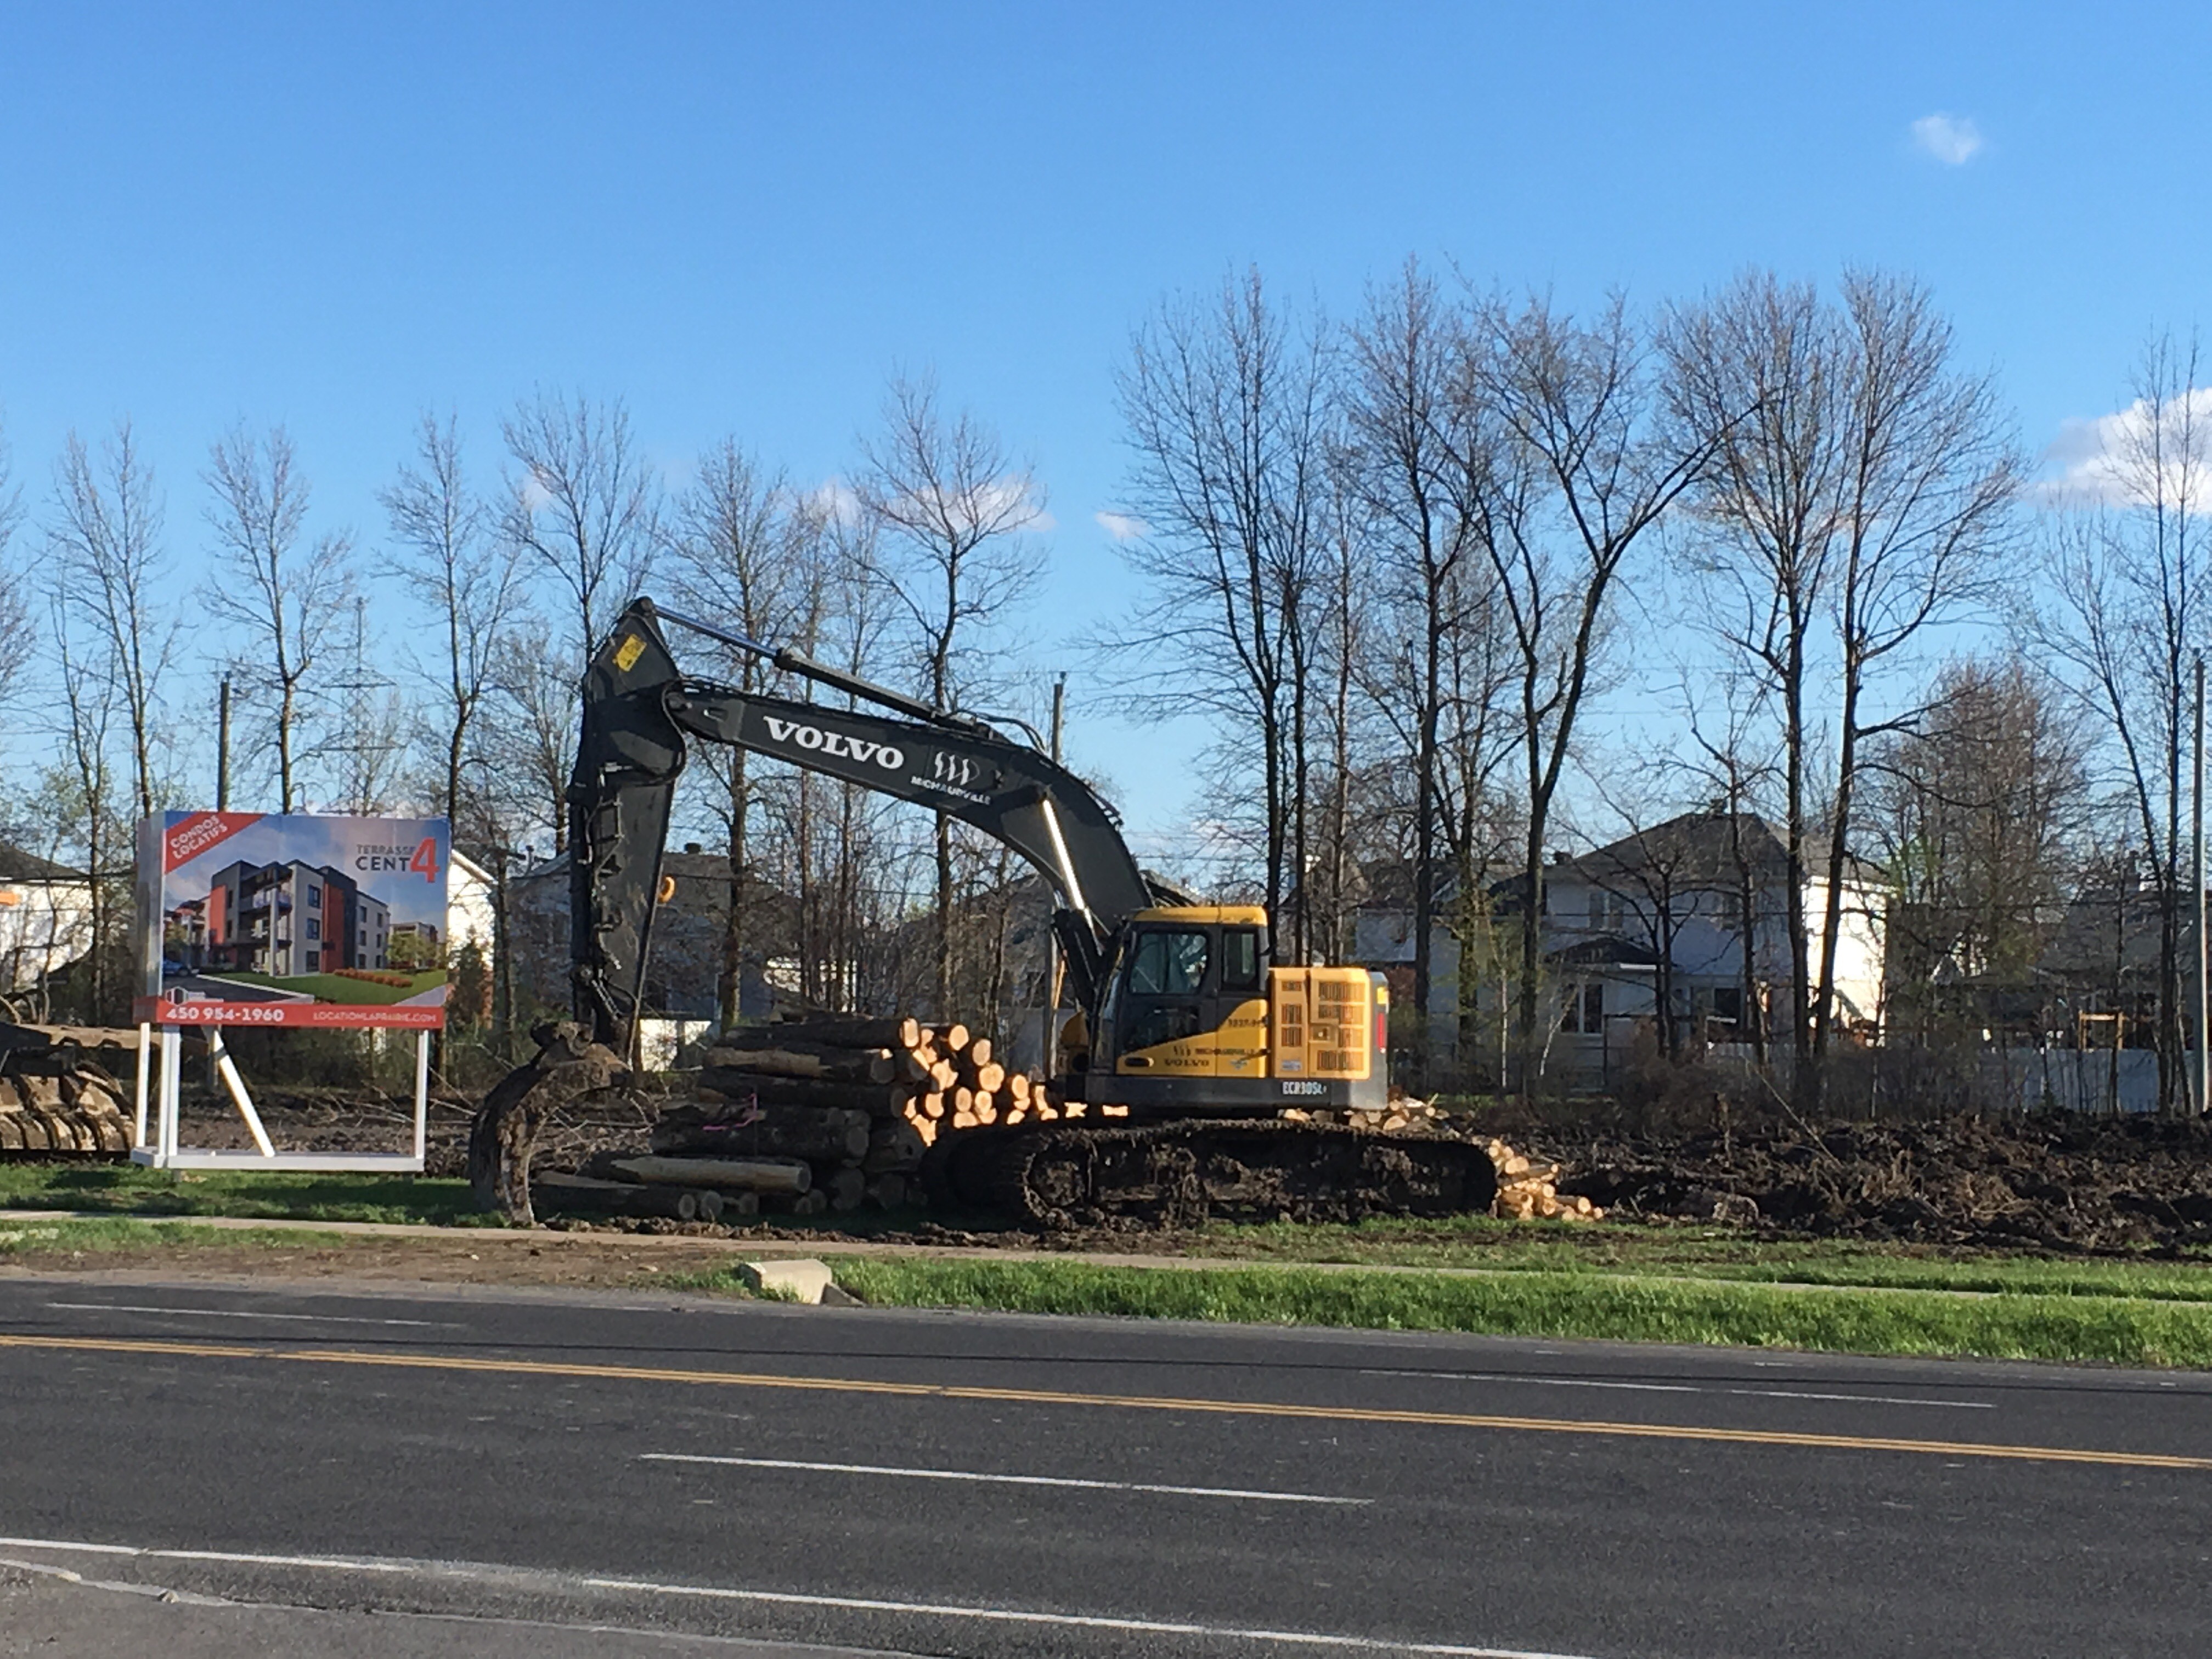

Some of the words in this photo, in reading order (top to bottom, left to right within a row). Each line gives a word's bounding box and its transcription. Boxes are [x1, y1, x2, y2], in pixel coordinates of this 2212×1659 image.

[763, 716, 904, 769] VOLVO
[170, 815, 219, 848] CONDOS
[172, 823, 228, 859] LOCATIFS
[166, 1007, 199, 1019] 450
